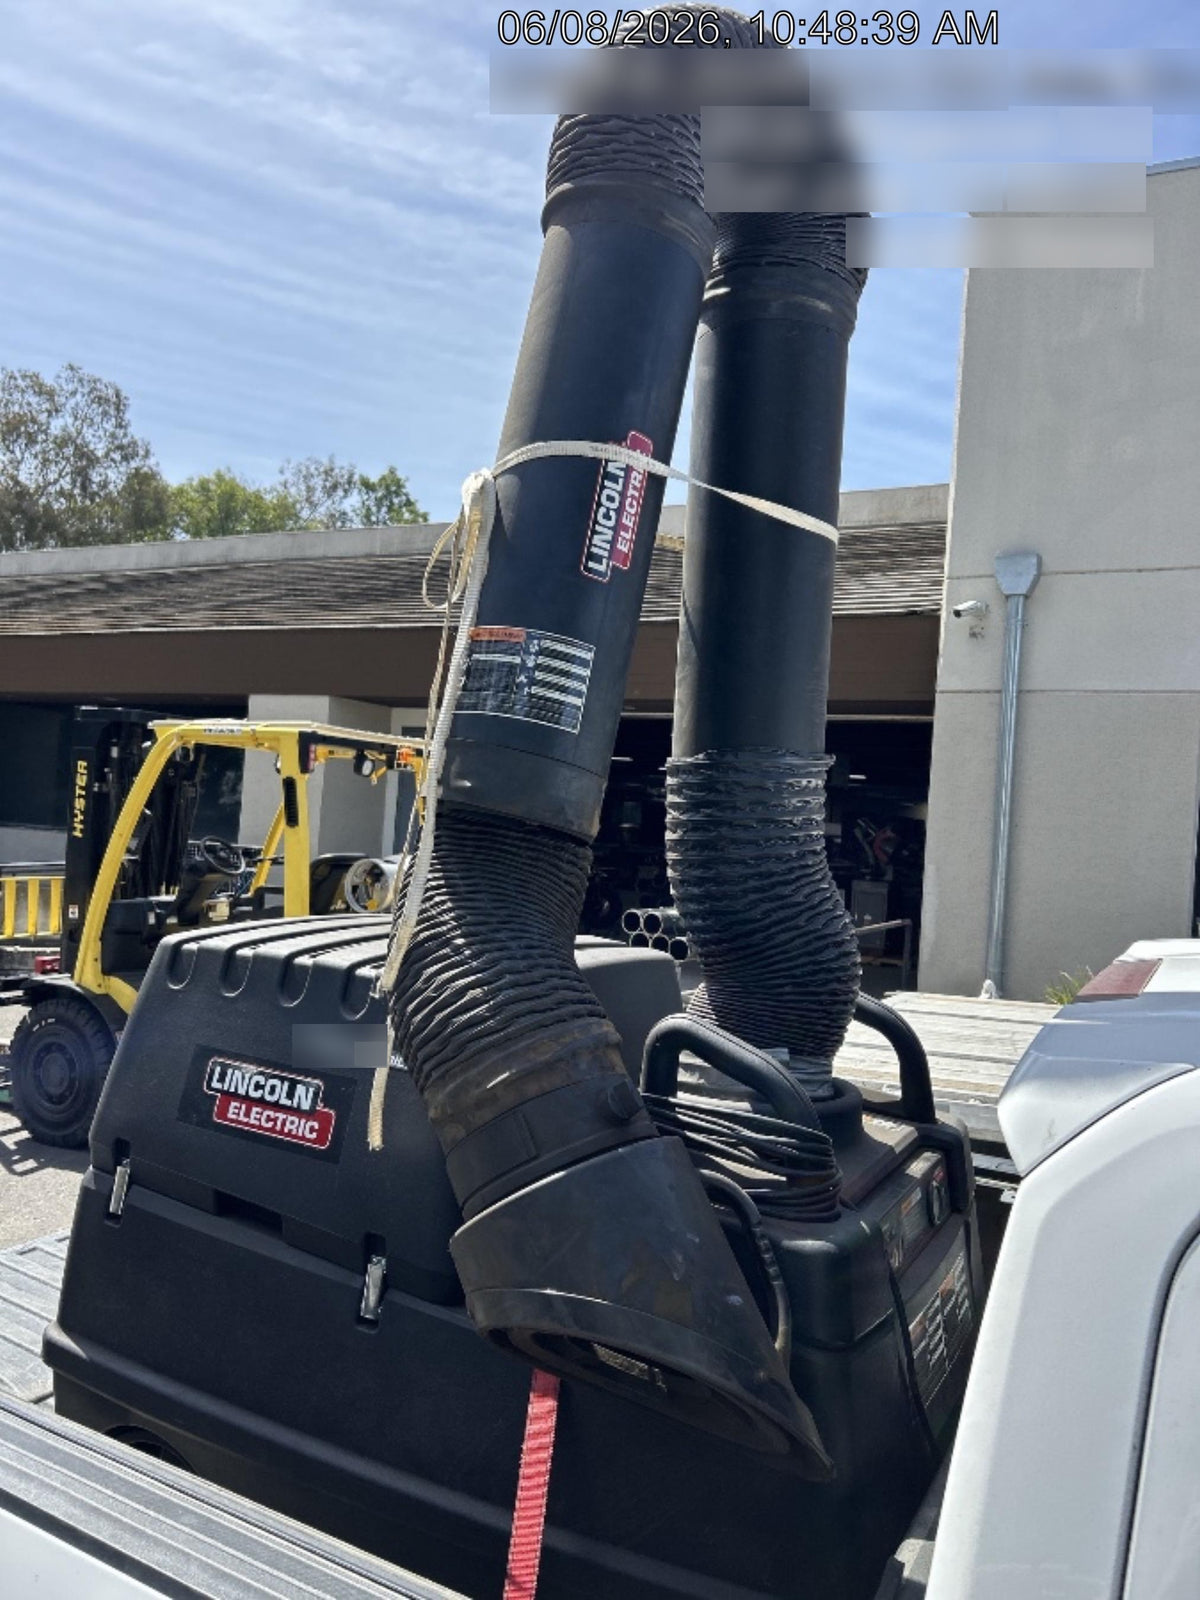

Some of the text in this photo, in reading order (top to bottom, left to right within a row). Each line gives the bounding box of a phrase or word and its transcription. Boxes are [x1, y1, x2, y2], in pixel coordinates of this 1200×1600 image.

[617, 450, 647, 554] ELECTR
[73, 761, 87, 838] HYSTER
[210, 1065, 316, 1111] LINCOLN
[226, 1100, 320, 1139] ELECTRIC
